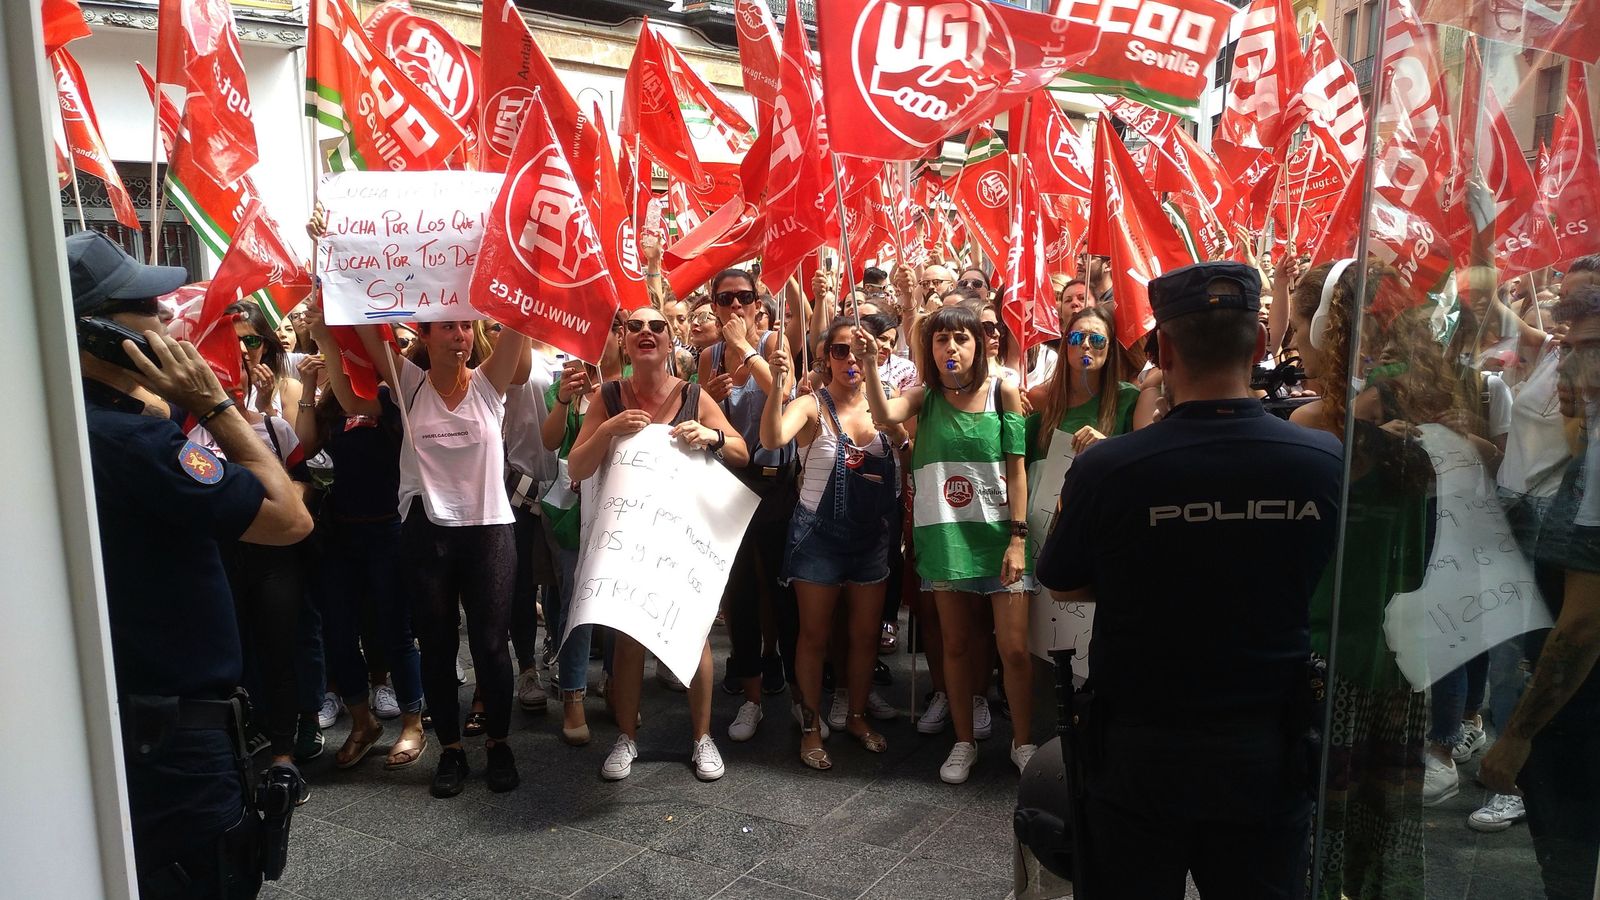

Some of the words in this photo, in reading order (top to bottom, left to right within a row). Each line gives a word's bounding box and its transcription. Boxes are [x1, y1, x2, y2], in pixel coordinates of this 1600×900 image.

[1124, 39, 1200, 79] Sevilla
[358, 92, 407, 171] Sevilla
[417, 292, 431, 308] A
[440, 288, 460, 308] LA
[946, 480, 970, 494] UGT
[1149, 499, 1321, 526] POLICIA
